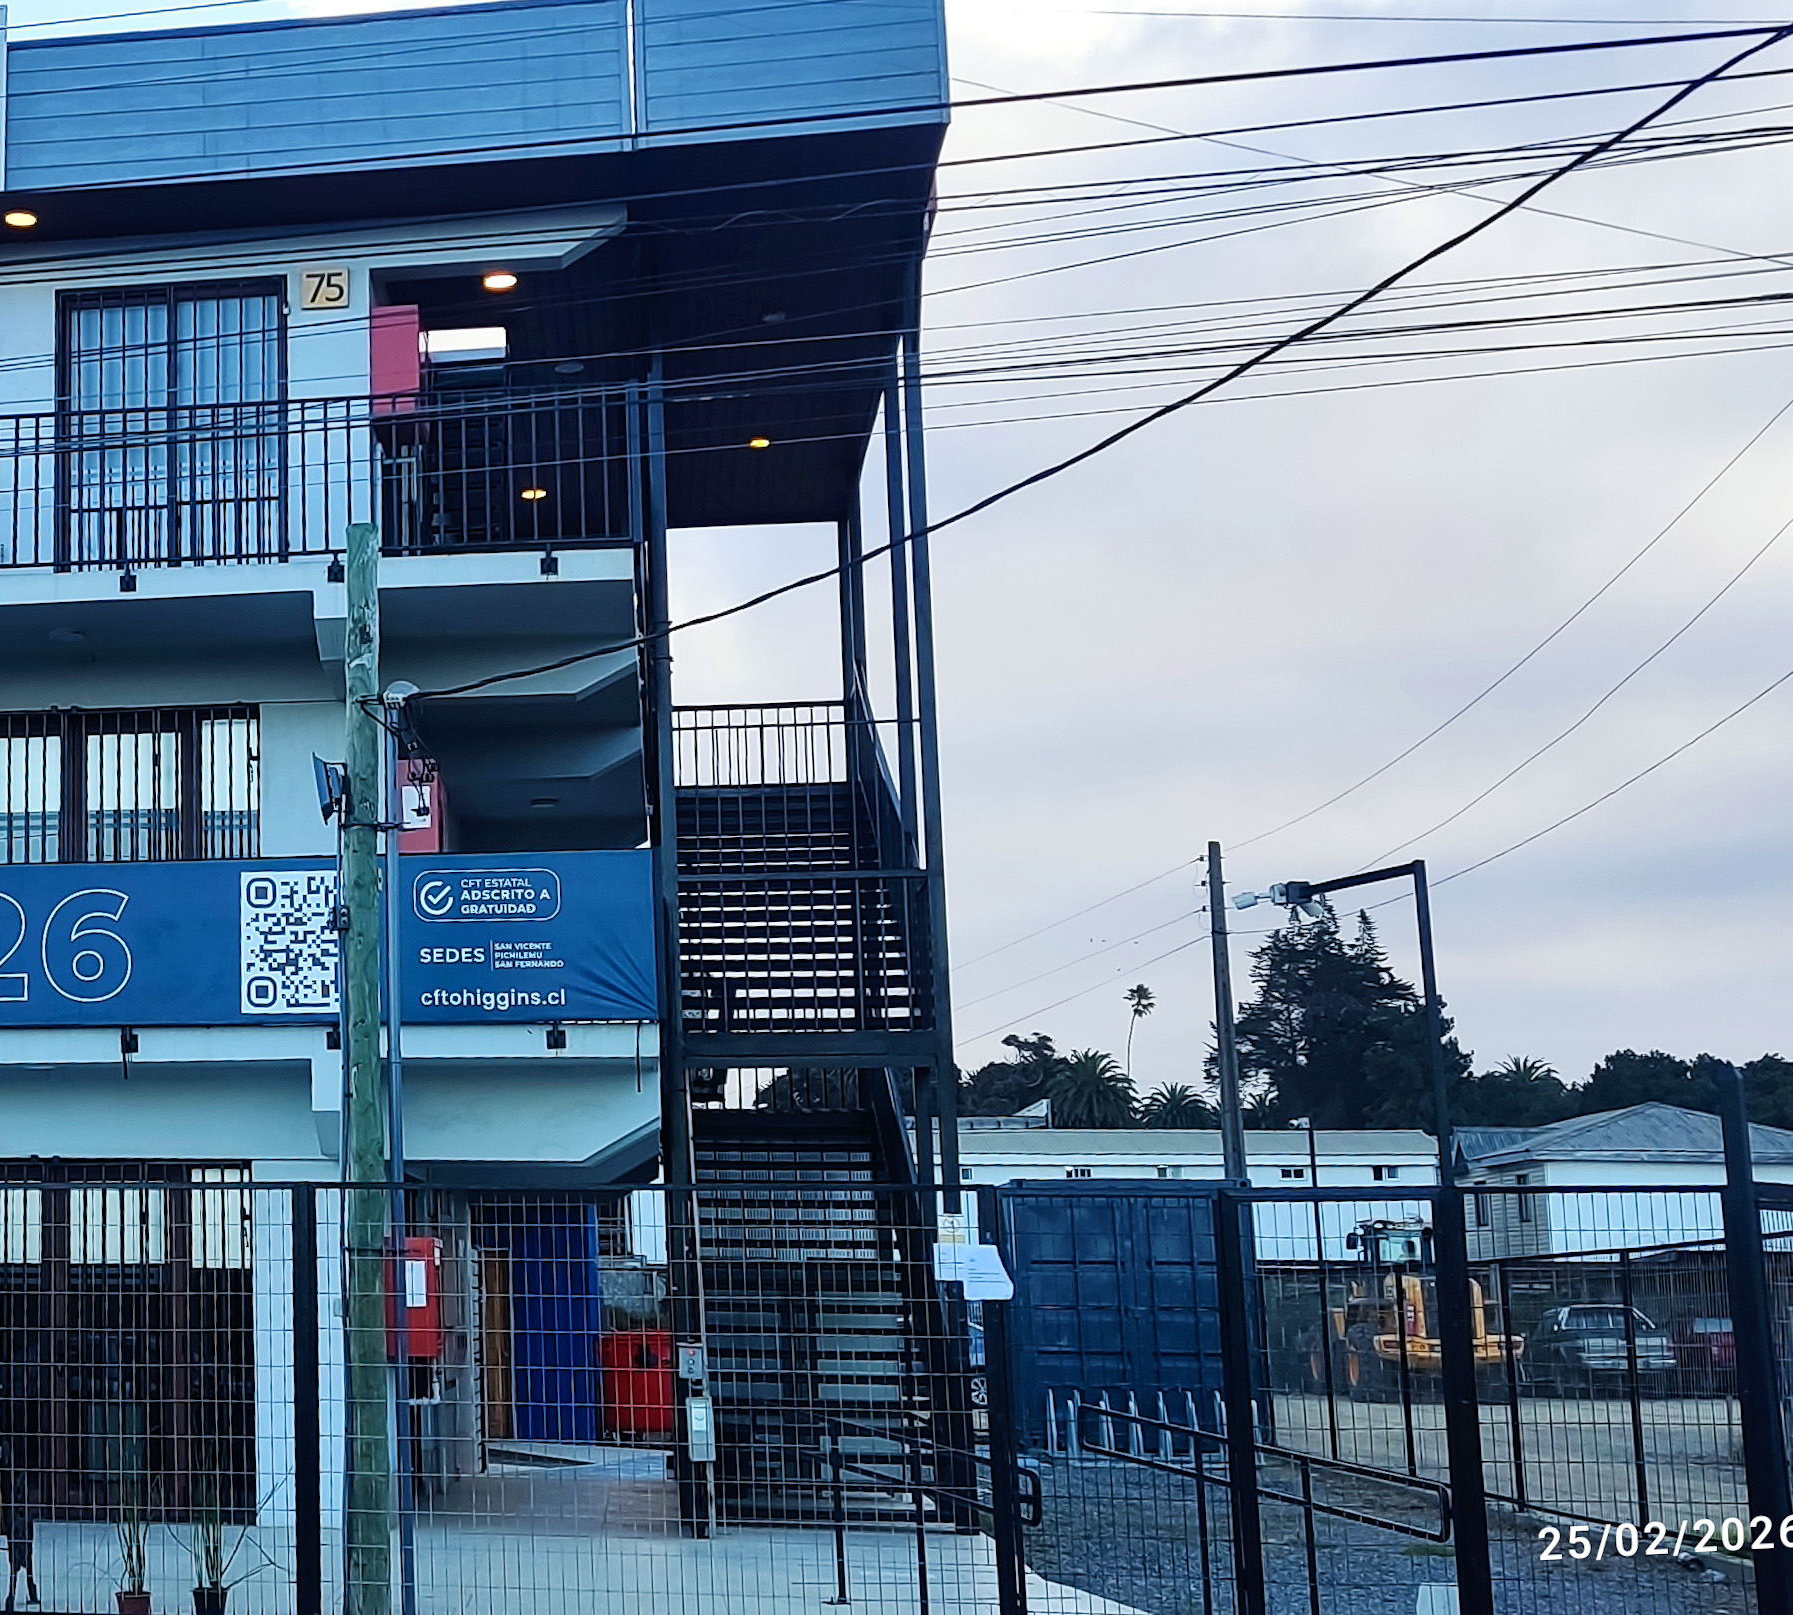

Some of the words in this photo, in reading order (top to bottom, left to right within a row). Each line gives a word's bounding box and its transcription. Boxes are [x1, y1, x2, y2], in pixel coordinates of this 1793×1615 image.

[305, 272, 345, 303] 75
[460, 878, 482, 888] CFT
[484, 877, 532, 888] ESTATAL
[460, 889, 535, 901] ADSCRITO
[539, 889, 551, 900] A
[460, 903, 537, 915] GRATUIDAD
[493, 942, 512, 950] SAN
[514, 942, 553, 950] VICENTE
[419, 947, 485, 963] SEDES
[494, 951, 543, 959] PICHILEMU
[494, 960, 513, 969] SAN
[514, 960, 565, 968] FERNANDO
[420, 988, 566, 1011] cftohiggins.cl
